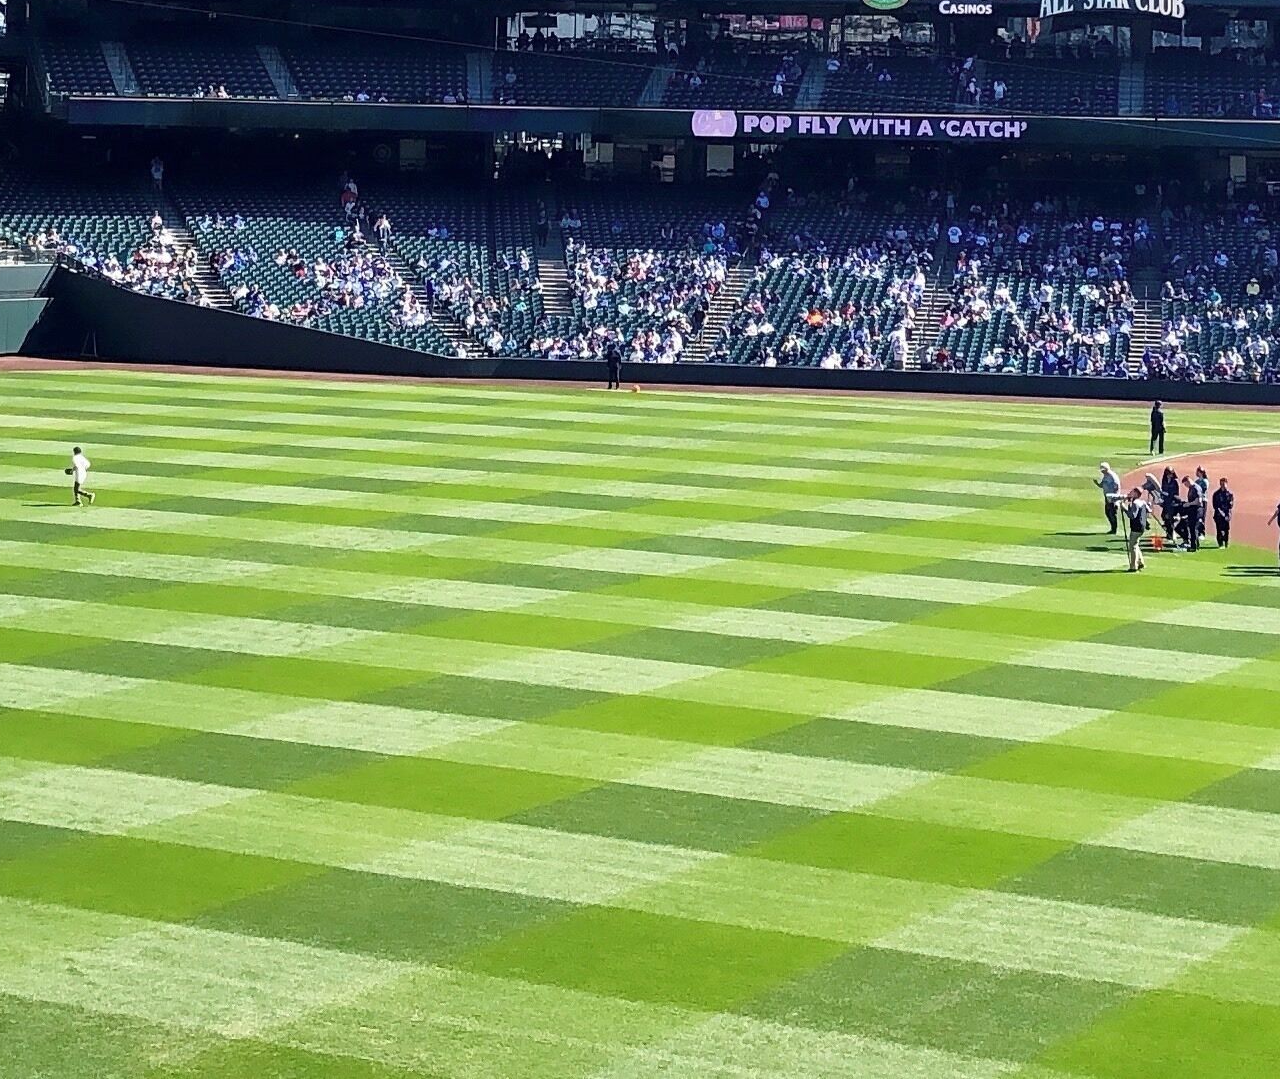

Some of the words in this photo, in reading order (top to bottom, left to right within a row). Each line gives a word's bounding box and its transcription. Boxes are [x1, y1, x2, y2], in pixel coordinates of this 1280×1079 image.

[939, 0, 992, 15] CASINOS
[743, 114, 792, 133] POP
[798, 116, 842, 134] FLY
[848, 118, 910, 136] WITH
[917, 120, 934, 136] A
